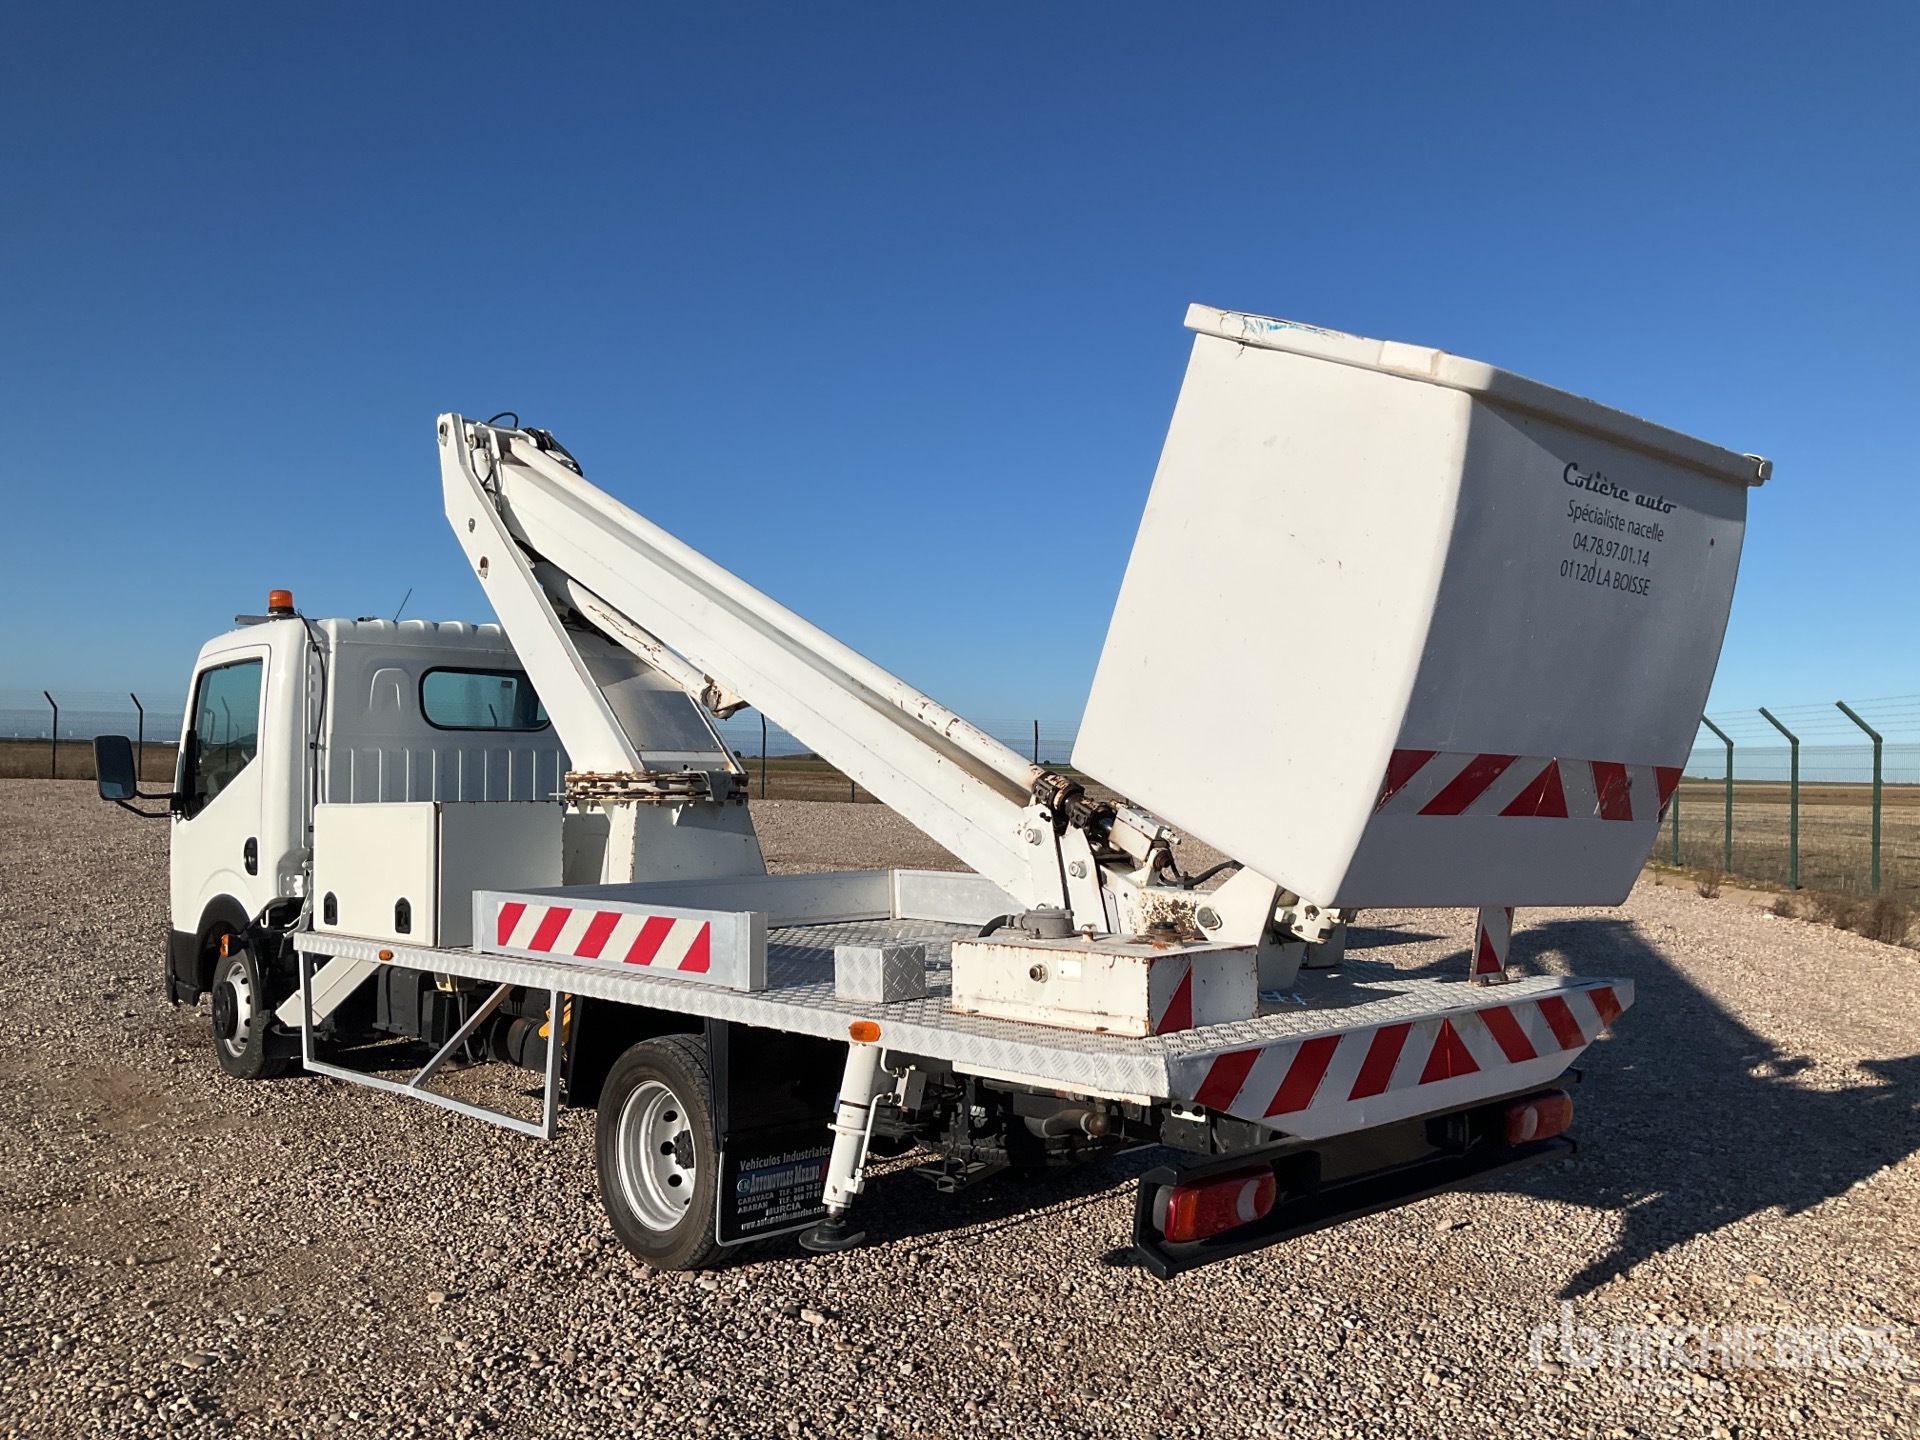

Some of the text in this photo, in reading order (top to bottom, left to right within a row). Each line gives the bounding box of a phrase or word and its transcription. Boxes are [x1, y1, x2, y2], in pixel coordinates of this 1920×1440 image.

[1635, 494, 1677, 513] auto
[1567, 499, 1664, 542] Spécialiste nacelle
[1573, 532, 1650, 567] 04.78.97.01.14
[1560, 559, 1651, 596] 01120 LA BOISSE
[783, 1146, 831, 1163] Industriales
[737, 1201, 768, 1214] ABARAN
[738, 1192, 774, 1206] CARAVACA
[765, 1202, 801, 1216] MURCIA
